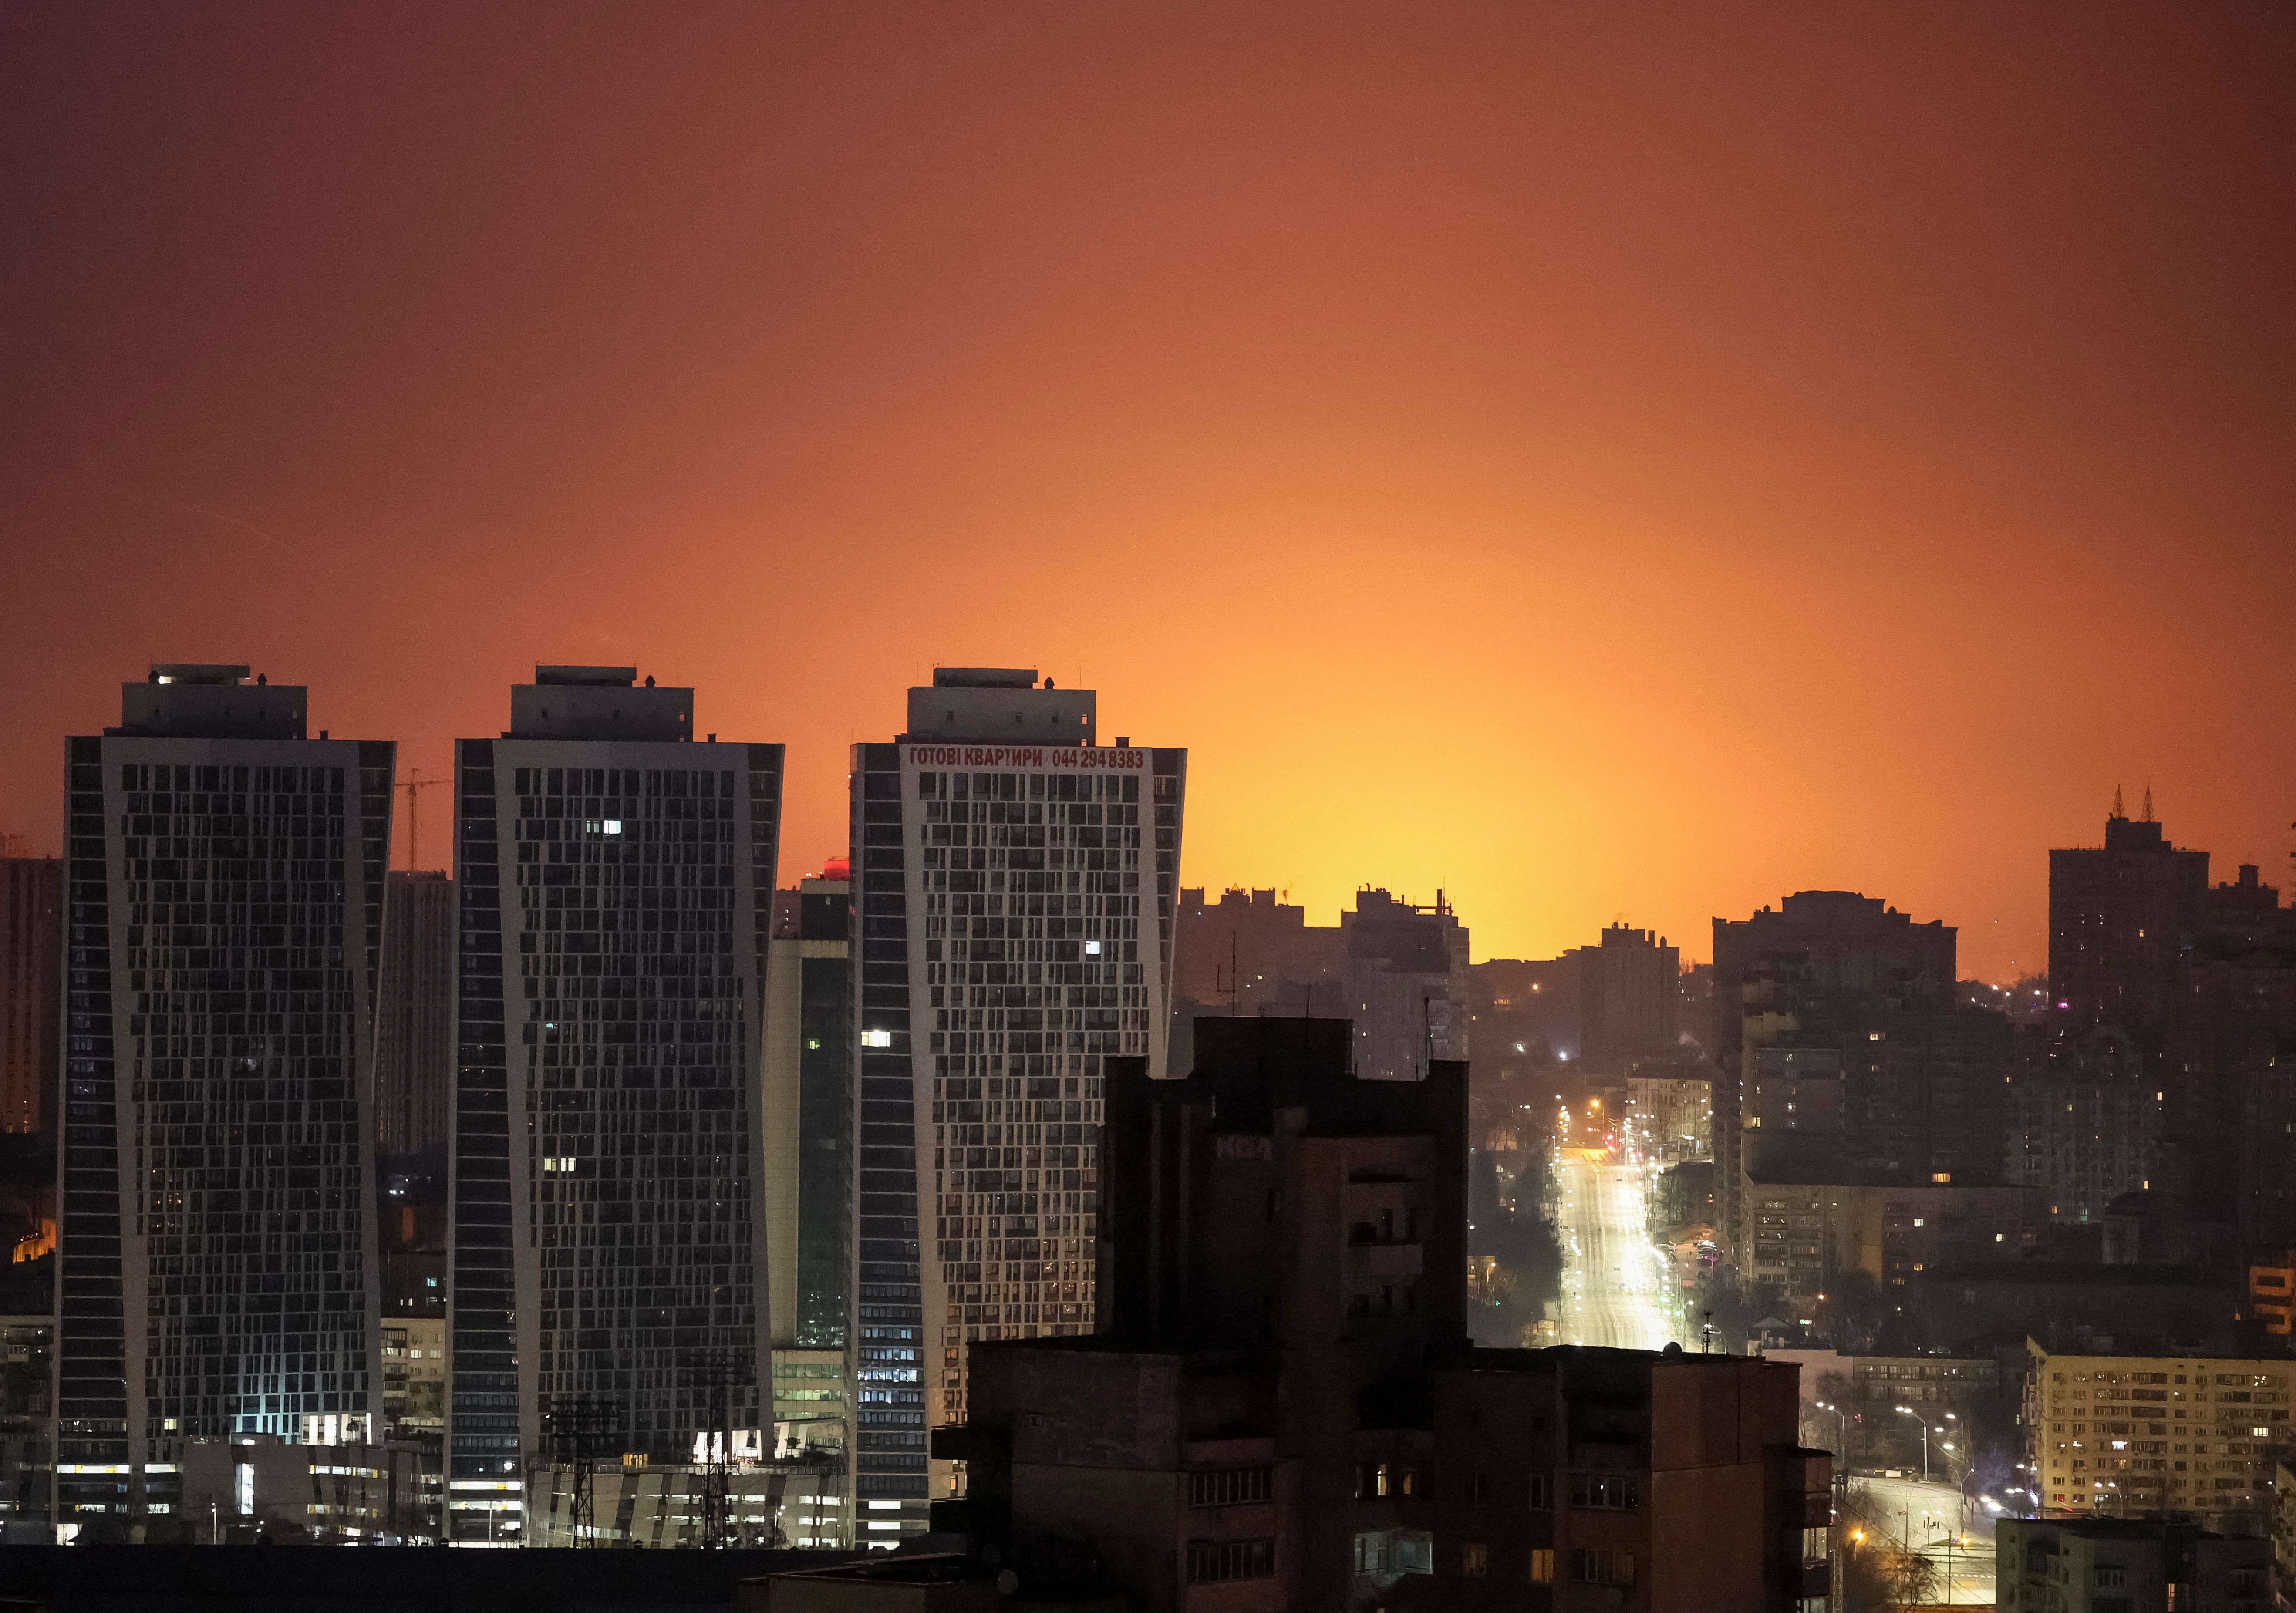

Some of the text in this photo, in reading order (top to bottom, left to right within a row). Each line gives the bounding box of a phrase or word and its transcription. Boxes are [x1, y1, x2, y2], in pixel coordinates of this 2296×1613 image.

[910, 747, 1143, 768] ГОТОВІ КВАРТИРИ 044 294 8383
